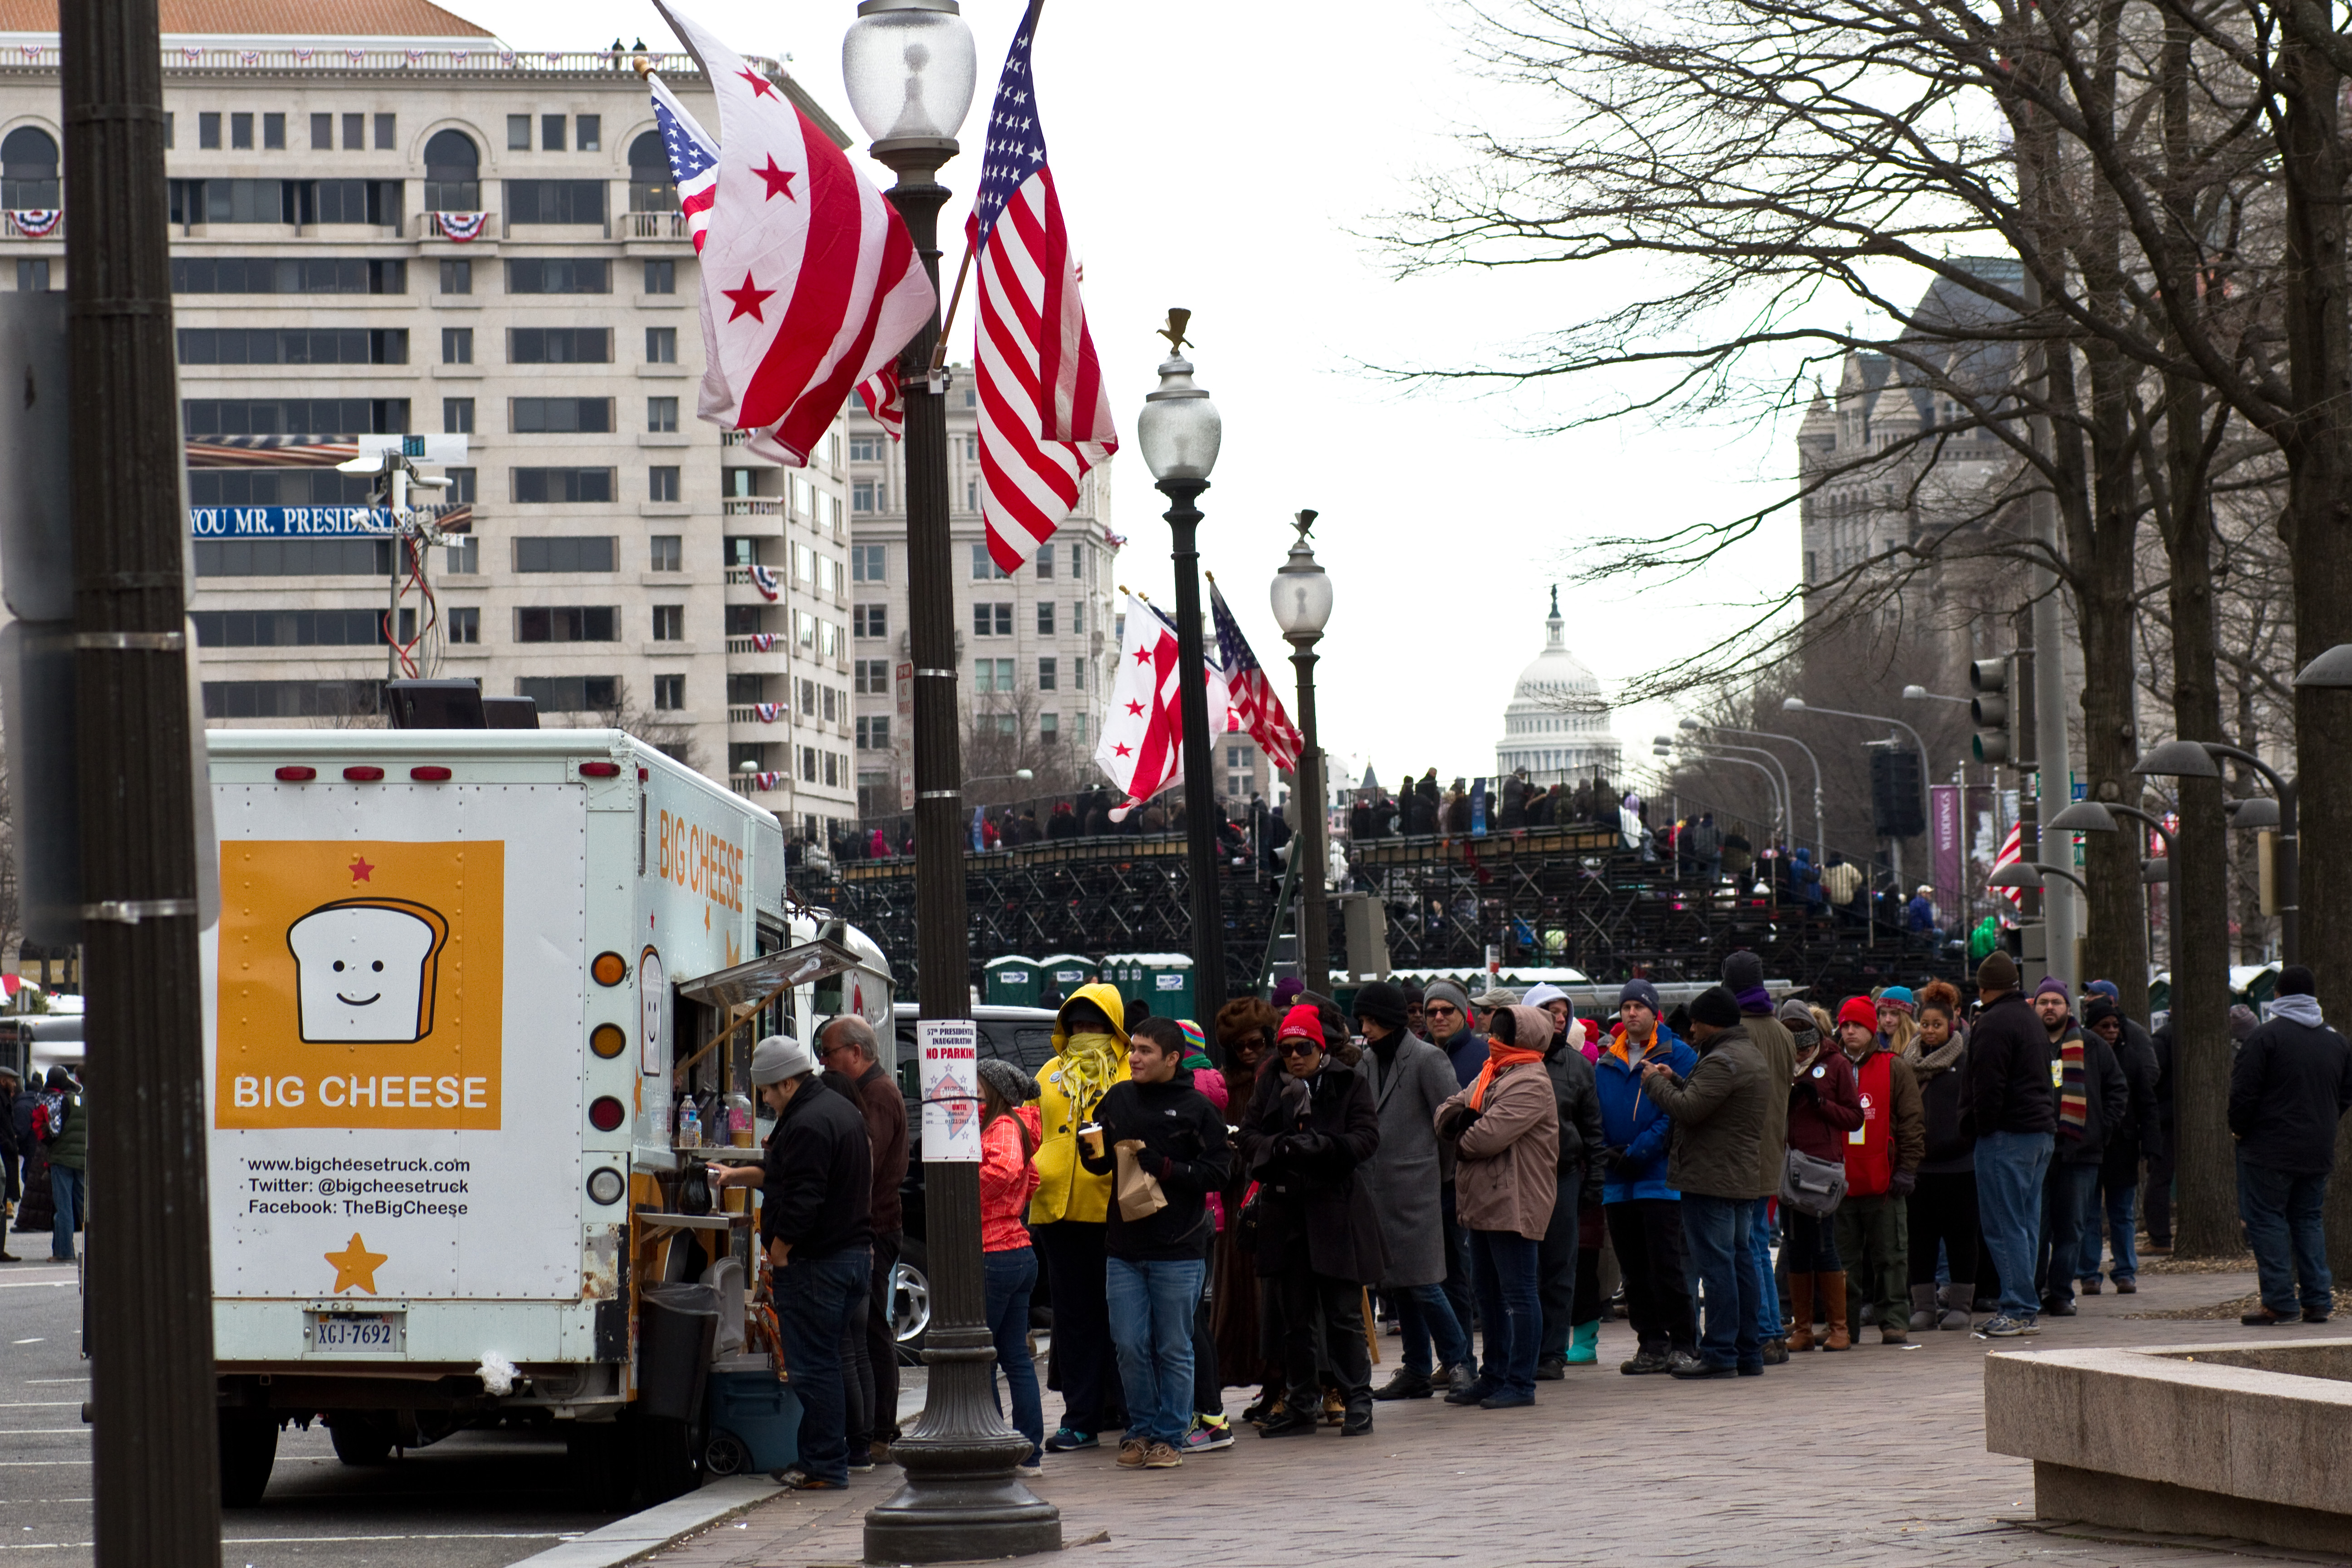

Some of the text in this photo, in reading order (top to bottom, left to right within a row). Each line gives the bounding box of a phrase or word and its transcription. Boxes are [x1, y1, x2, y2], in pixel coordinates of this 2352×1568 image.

[189, 507, 394, 534] YOU MR. PRESIDN
[1940, 792, 1951, 851] WEDDINGS
[660, 809, 743, 913] BIG CHEESE
[926, 1048, 975, 1059] NO PARKING
[234, 1076, 487, 1108] BIG CHEESE
[248, 1157, 470, 1174] www.bigcheesetruck.com
[249, 1178, 469, 1196] Twitter: @bigcheesetruck
[250, 1200, 468, 1218] Facebook: TheBigCheese
[318, 1324, 391, 1344] XGJ-7692
